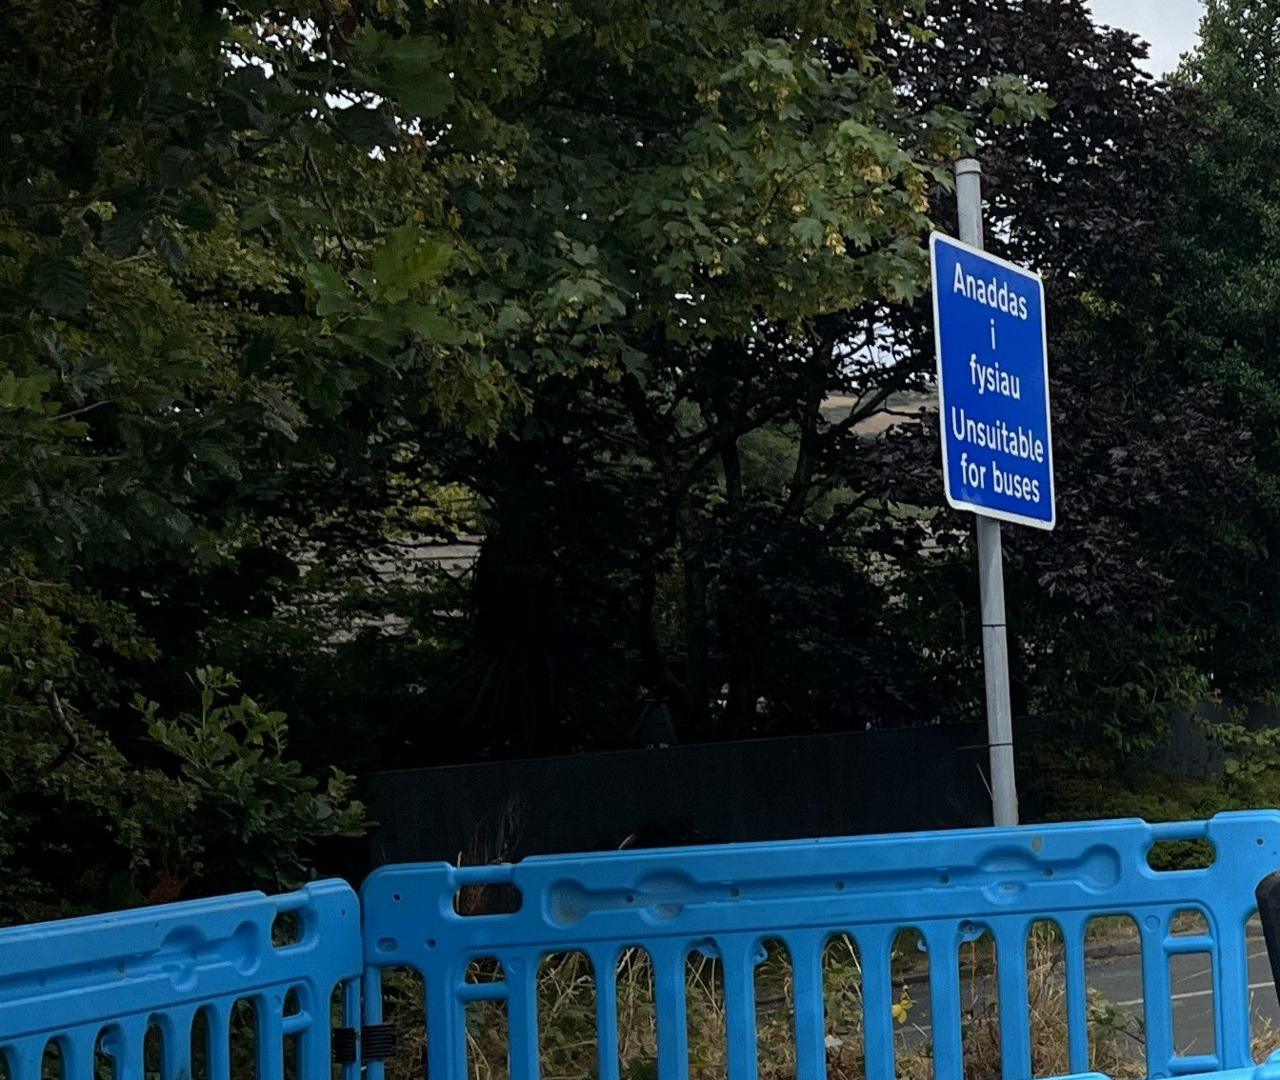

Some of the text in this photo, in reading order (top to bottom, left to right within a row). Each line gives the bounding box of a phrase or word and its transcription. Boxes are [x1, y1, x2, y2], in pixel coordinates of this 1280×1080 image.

[953, 262, 1028, 320] Anaddas
[990, 318, 997, 350] i
[969, 353, 1021, 400] fysiau
[951, 406, 1044, 464] Unsuitable
[960, 453, 1040, 503] for buses
